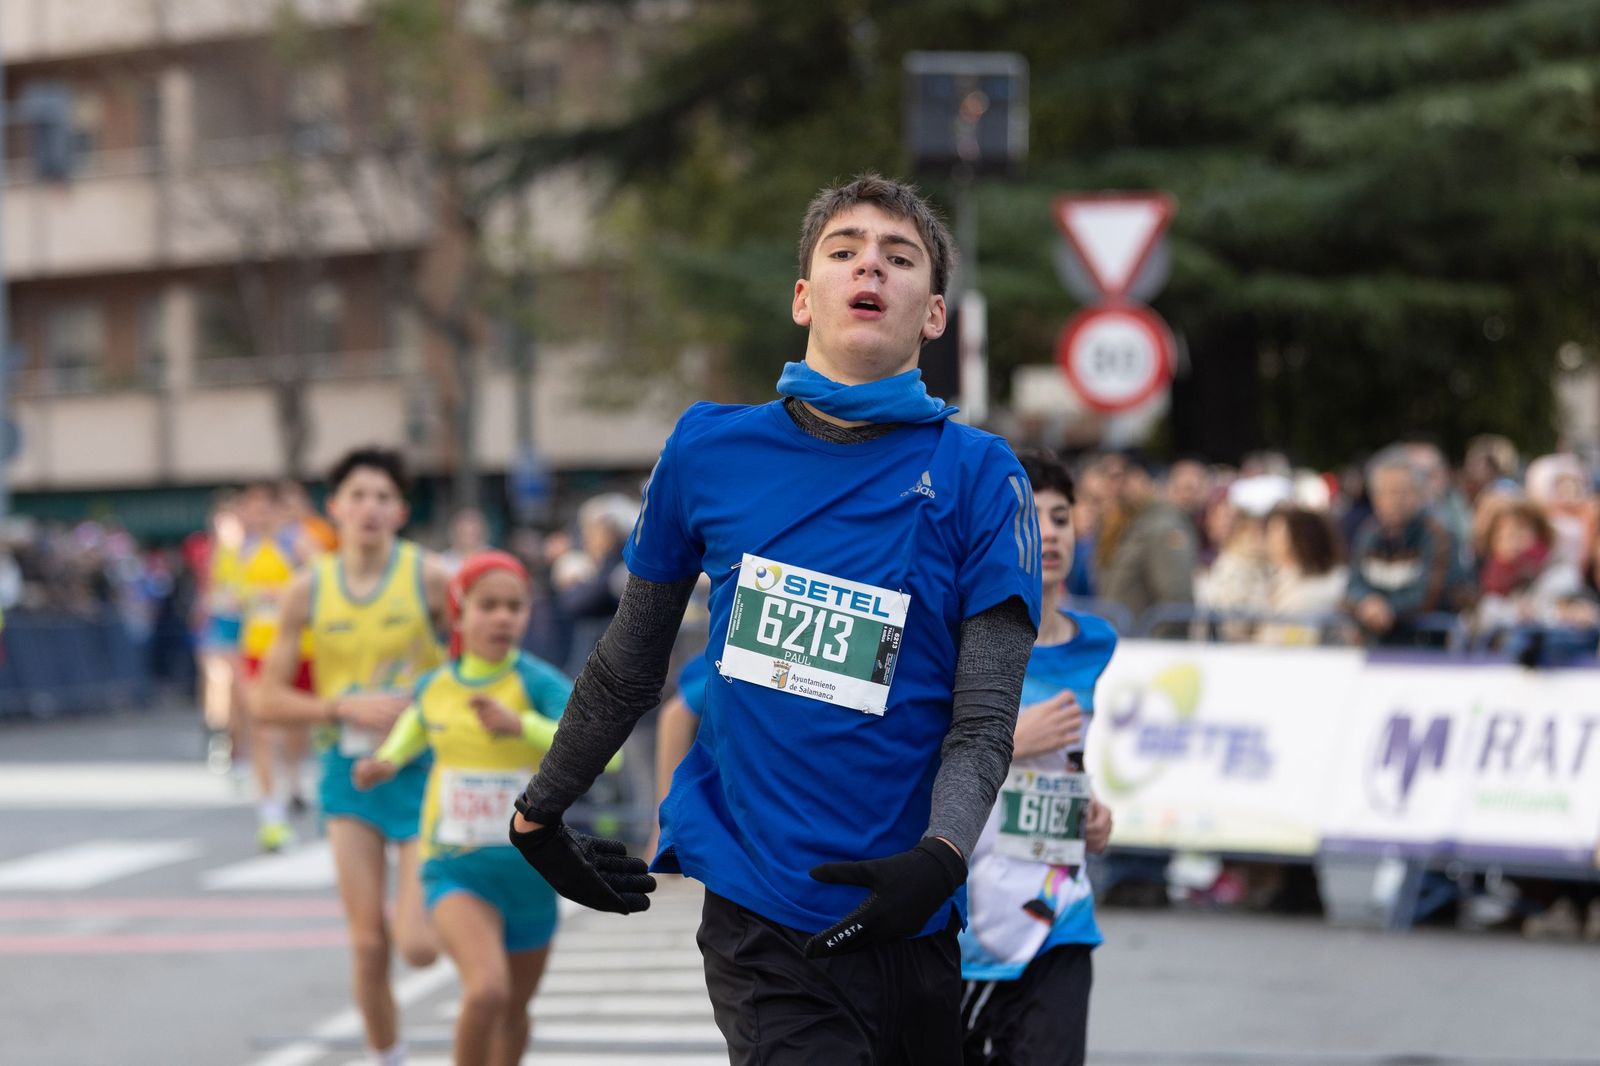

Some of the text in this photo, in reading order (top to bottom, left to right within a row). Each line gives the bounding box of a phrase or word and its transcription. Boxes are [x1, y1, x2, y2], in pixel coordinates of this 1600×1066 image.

[783, 574, 890, 618] SETEL
[756, 595, 855, 664] 6213
[784, 651, 811, 666] PAUL
[789, 683, 834, 701] de Salamanca
[791, 673, 836, 692] Ayuntamiento
[826, 923, 864, 948] KIPSTA
